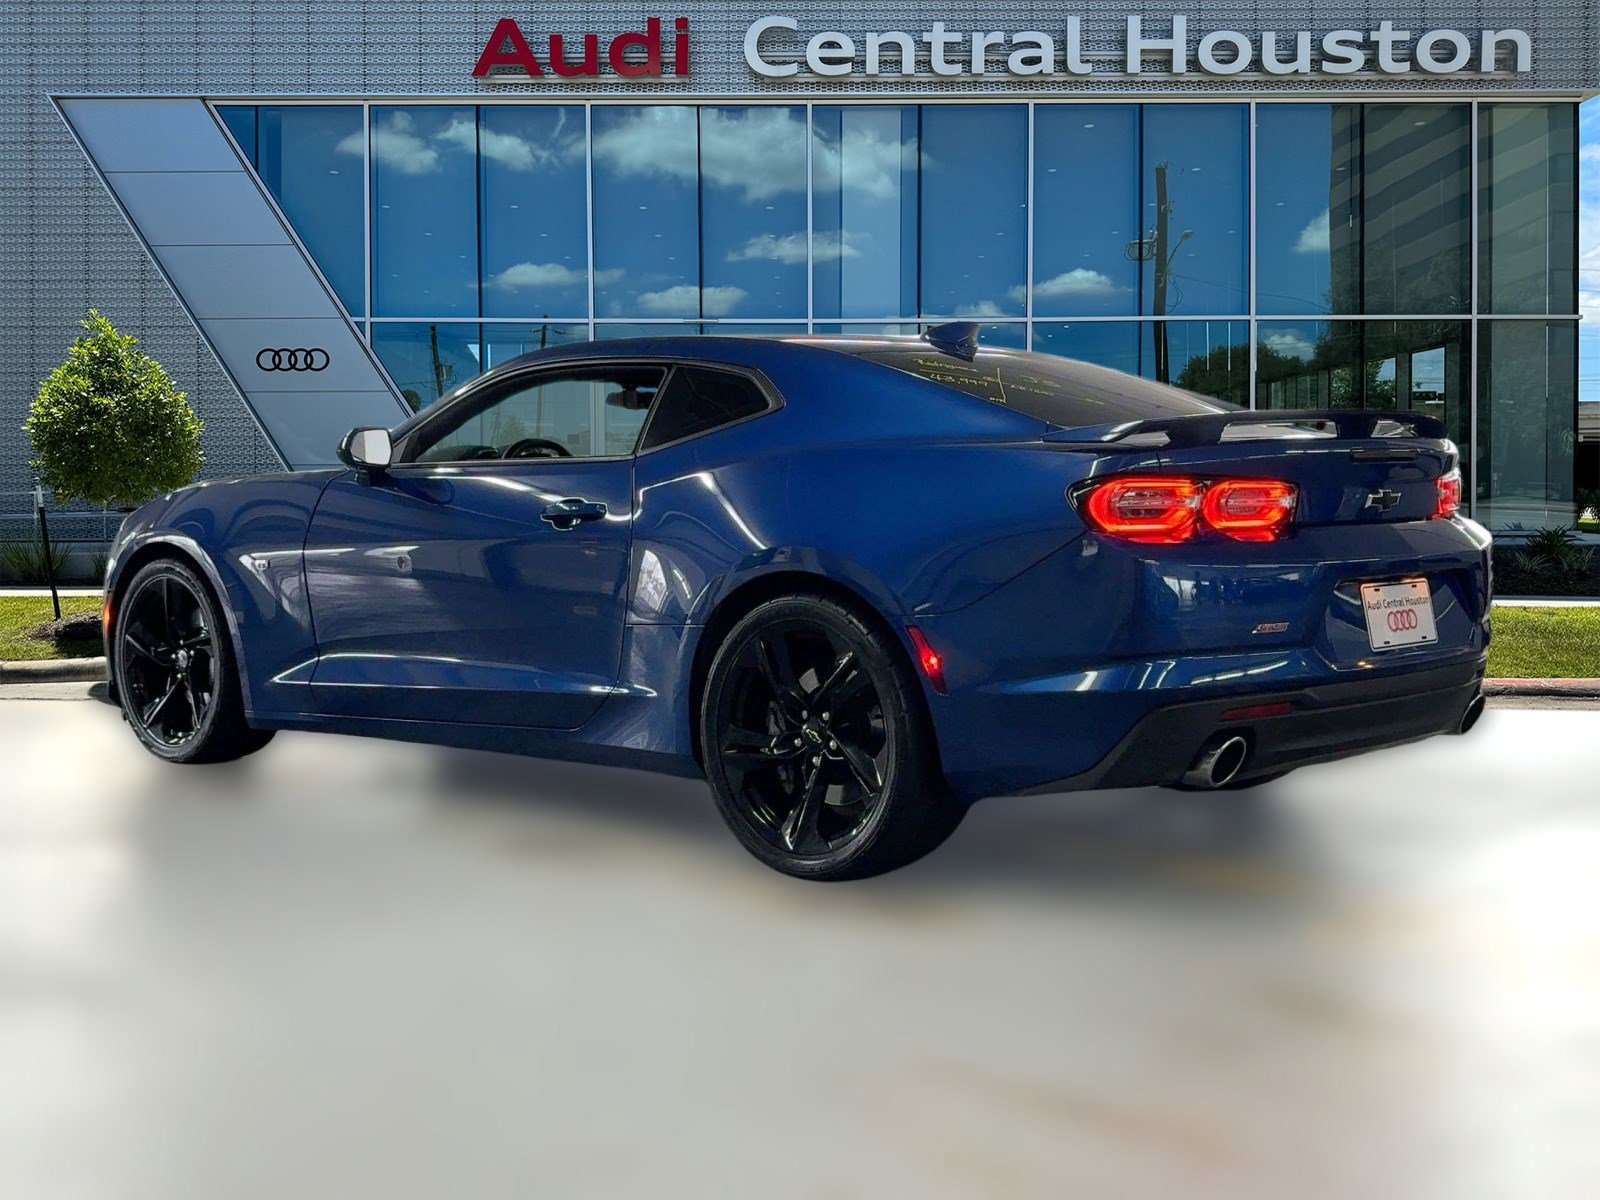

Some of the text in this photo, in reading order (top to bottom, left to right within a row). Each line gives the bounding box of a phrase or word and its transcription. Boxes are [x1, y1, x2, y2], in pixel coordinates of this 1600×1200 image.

[471, 15, 1532, 78] Audi Central Houston
[1367, 596, 1429, 610] Audi Central Houston
